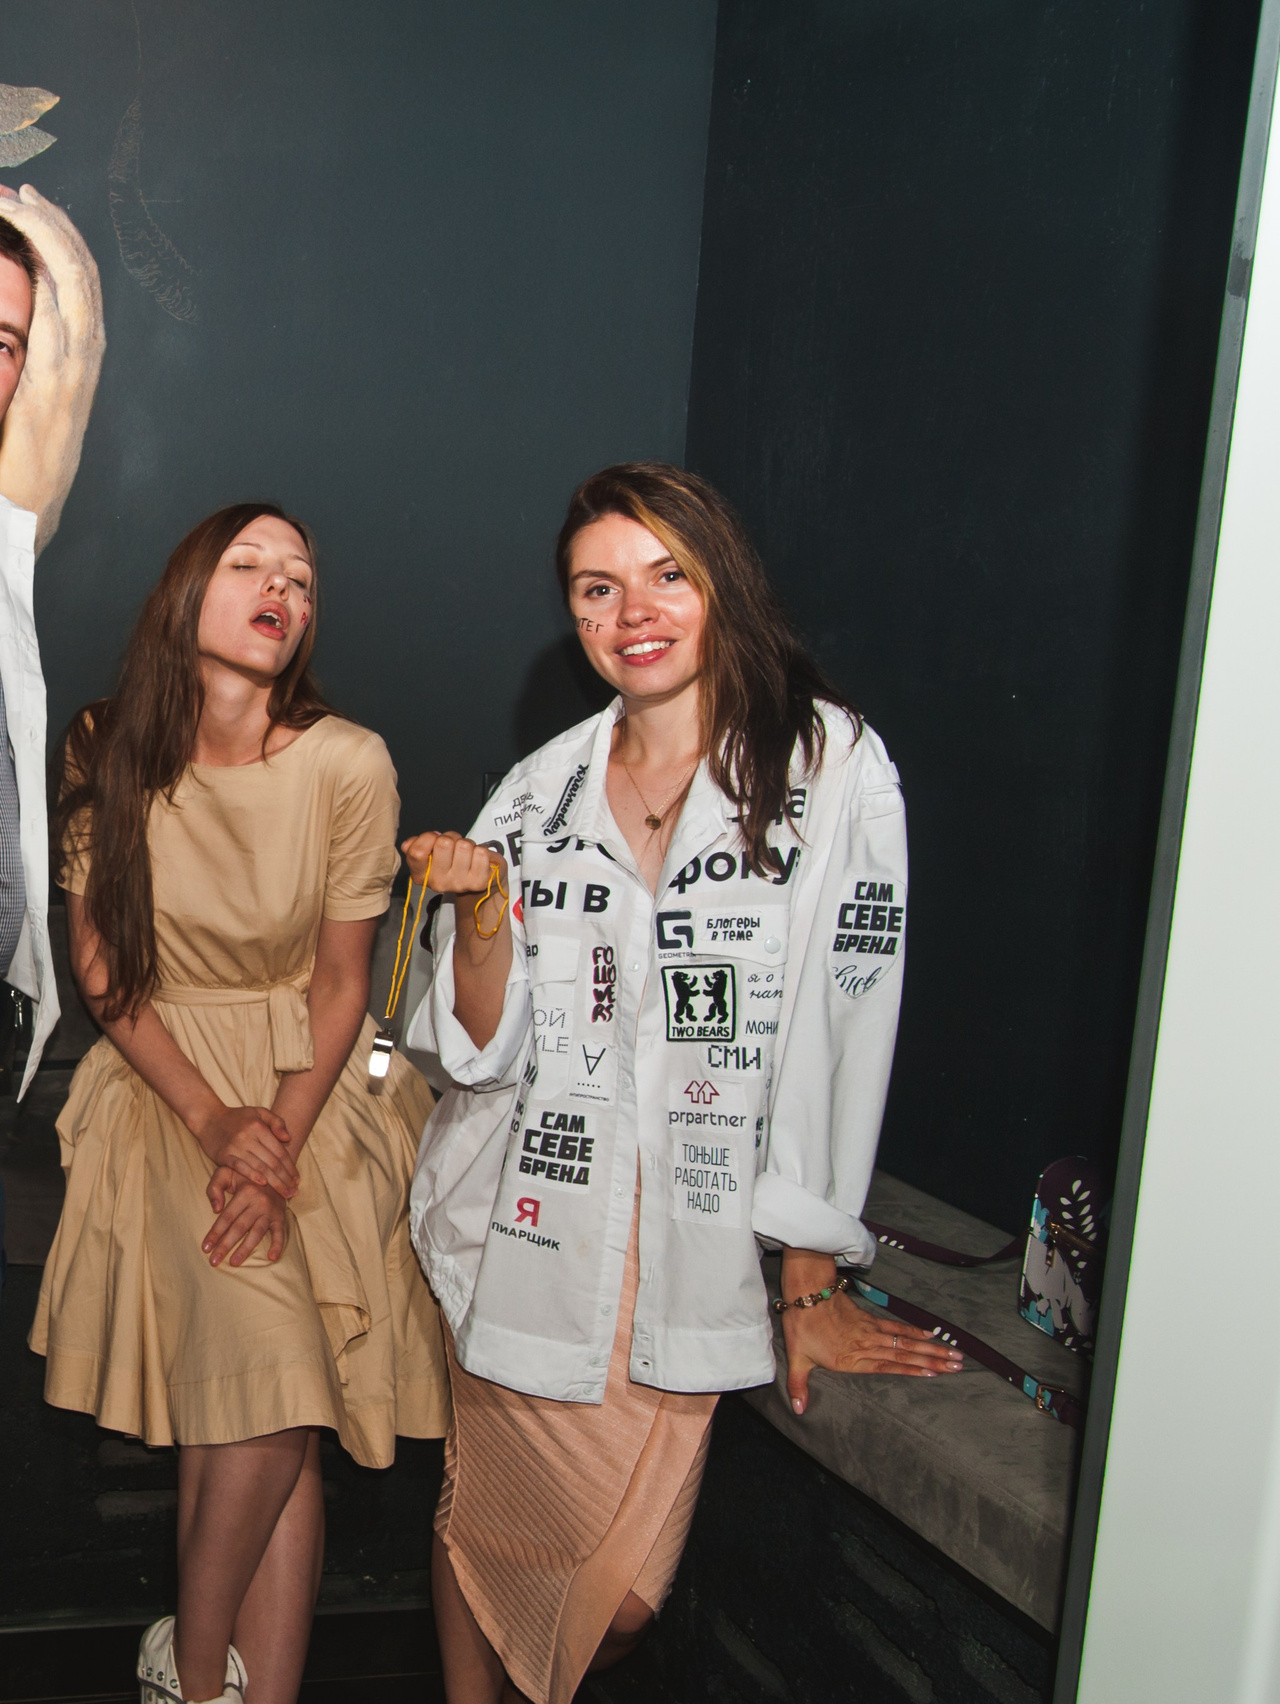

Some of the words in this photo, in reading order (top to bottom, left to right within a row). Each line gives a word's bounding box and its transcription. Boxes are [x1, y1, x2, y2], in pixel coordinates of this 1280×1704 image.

[854, 881, 893, 902] САМ
[837, 903, 904, 932] СЕБЕ
[832, 934, 898, 955] БРЕНД
[533, 1008, 566, 1028] ОЙ
[672, 1026, 694, 1037] TWO
[697, 1026, 730, 1037] BEARS
[708, 1045, 761, 1070] СМИ
[540, 1111, 585, 1134] САМ
[669, 1111, 746, 1127] prpartner
[522, 1129, 595, 1163] СЕБЕ
[682, 1143, 730, 1167] ТОНЬШЕ
[519, 1155, 590, 1186] БРЕНД
[675, 1167, 737, 1192] РАБОТАТЬ
[514, 1196, 540, 1228] Я
[687, 1191, 720, 1214] НАДО
[491, 1221, 561, 1251] ПИАРЩИК
